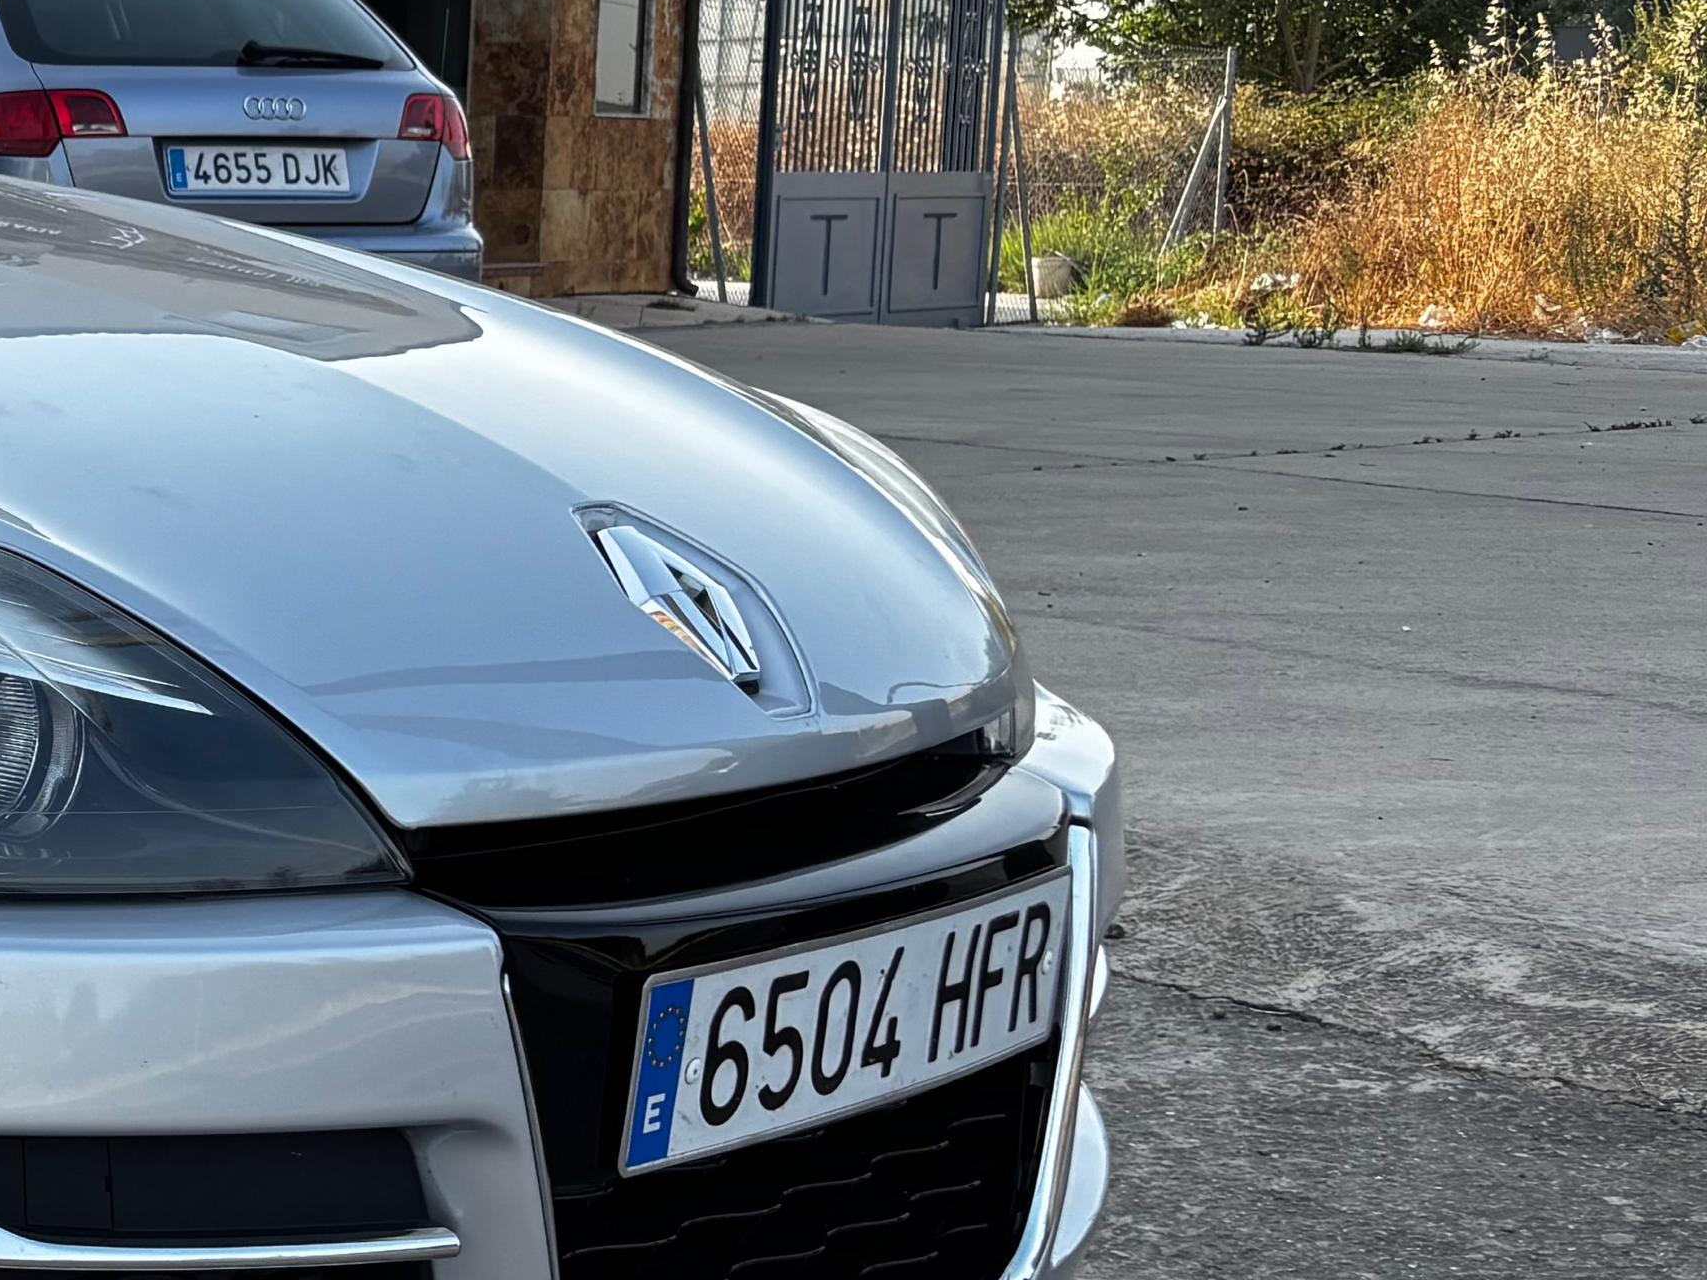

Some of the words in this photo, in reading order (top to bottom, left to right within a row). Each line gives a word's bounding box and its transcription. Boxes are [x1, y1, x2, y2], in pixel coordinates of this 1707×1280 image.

[193, 152, 272, 185] 4655
[282, 152, 341, 186] DJK
[642, 1093, 666, 1135] E
[699, 945, 905, 1128] 6504
[927, 900, 1051, 1064] HFR
